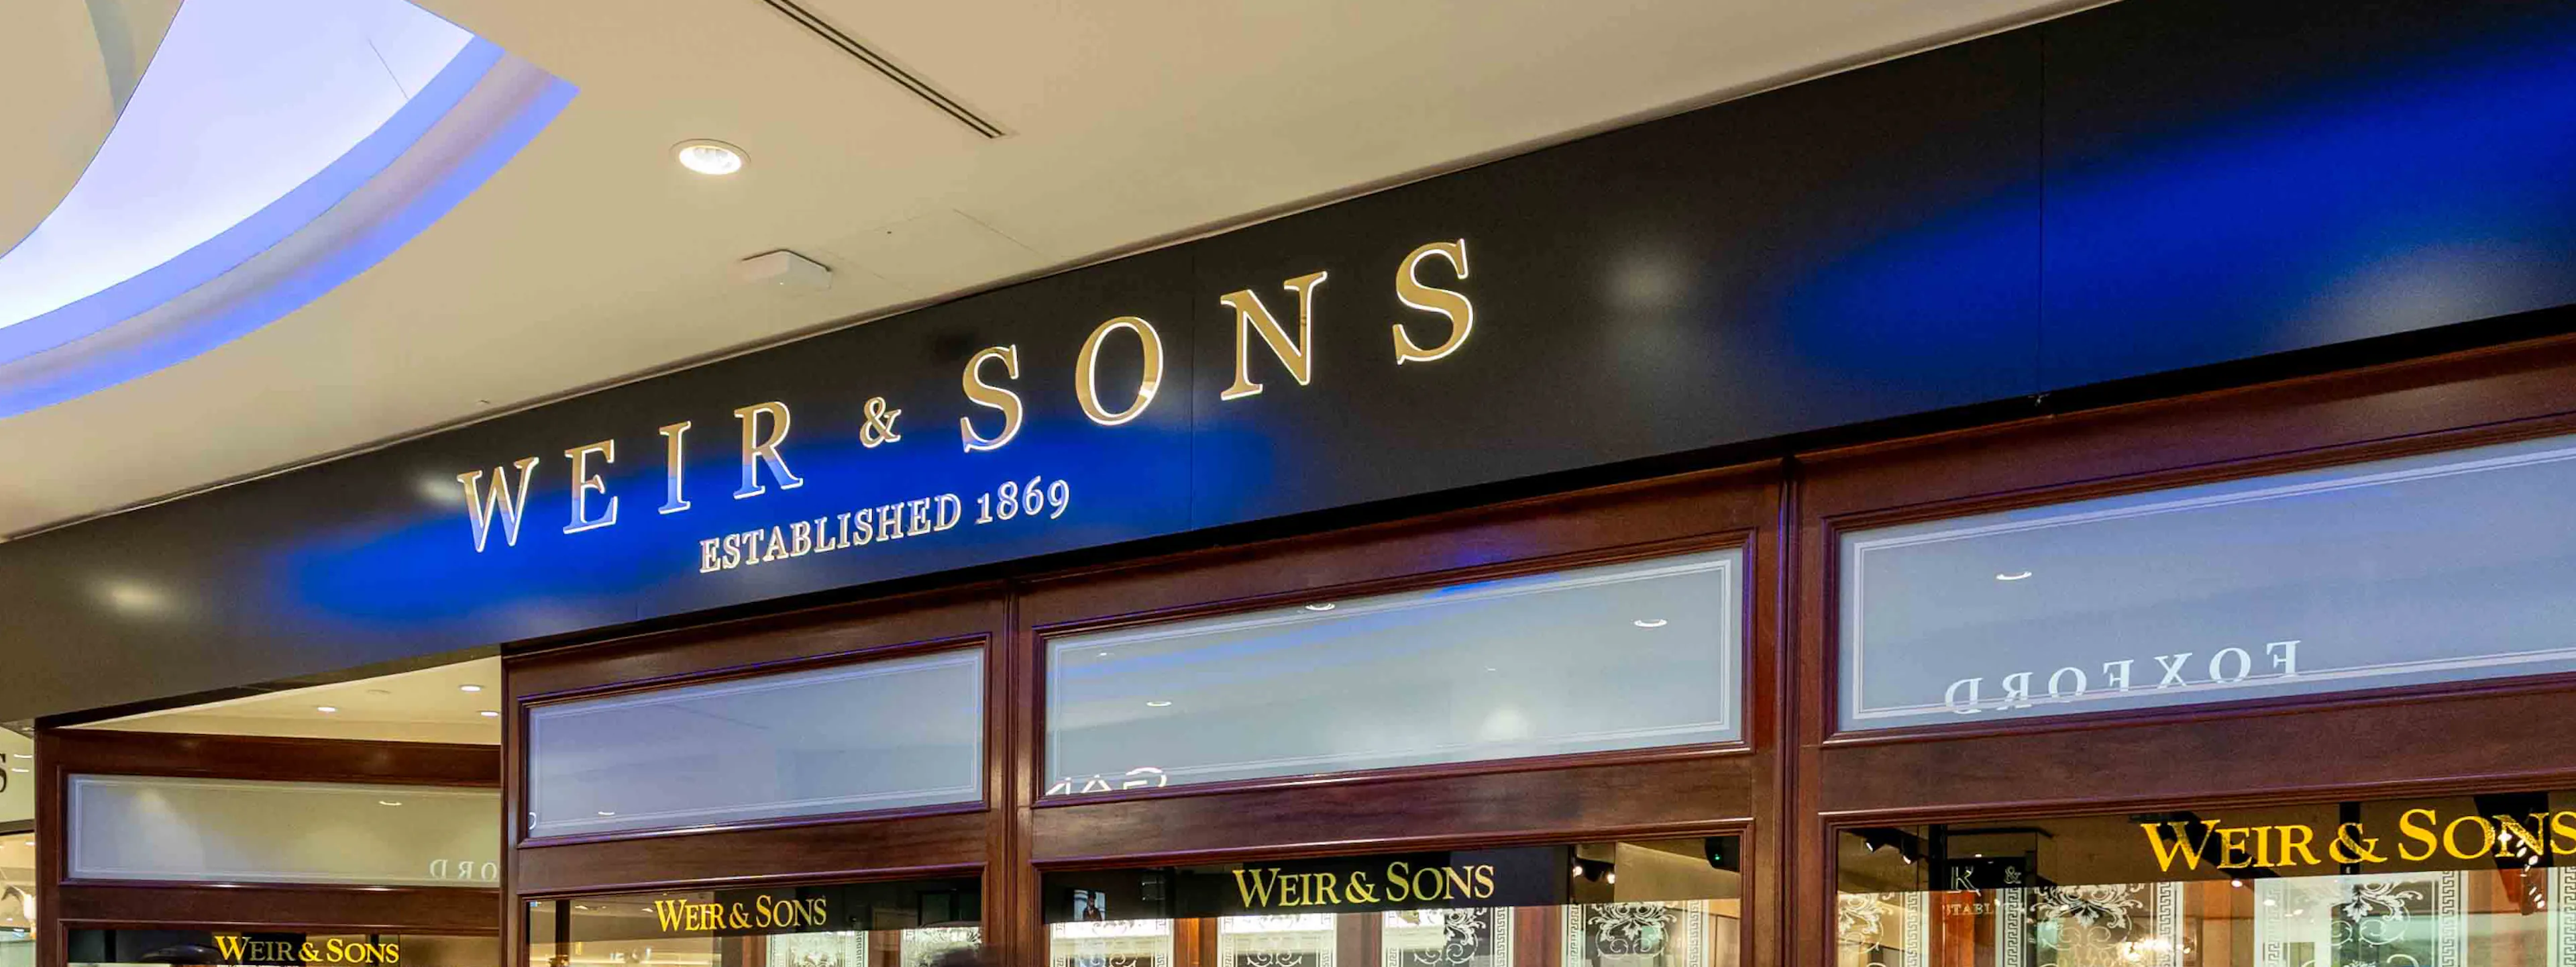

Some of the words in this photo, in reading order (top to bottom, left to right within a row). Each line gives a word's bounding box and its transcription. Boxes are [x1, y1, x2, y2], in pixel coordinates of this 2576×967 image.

[457, 401, 804, 553] WEIR
[859, 396, 902, 448] &
[960, 238, 1474, 453] SONS
[699, 493, 962, 573] ESTABLISHED
[975, 475, 1070, 525] 1869
[2140, 818, 2321, 872] WEIR
[2328, 822, 2387, 864] &
[1232, 868, 1341, 908] WEIR
[1345, 871, 1381, 904] &
[1386, 861, 1495, 901] SONS
[655, 899, 727, 932] WEIR
[729, 902, 753, 929] &
[755, 895, 827, 928] SONS
[214, 935, 297, 962] WEIR
[297, 941, 323, 962] &
[326, 937, 400, 964] SONS
